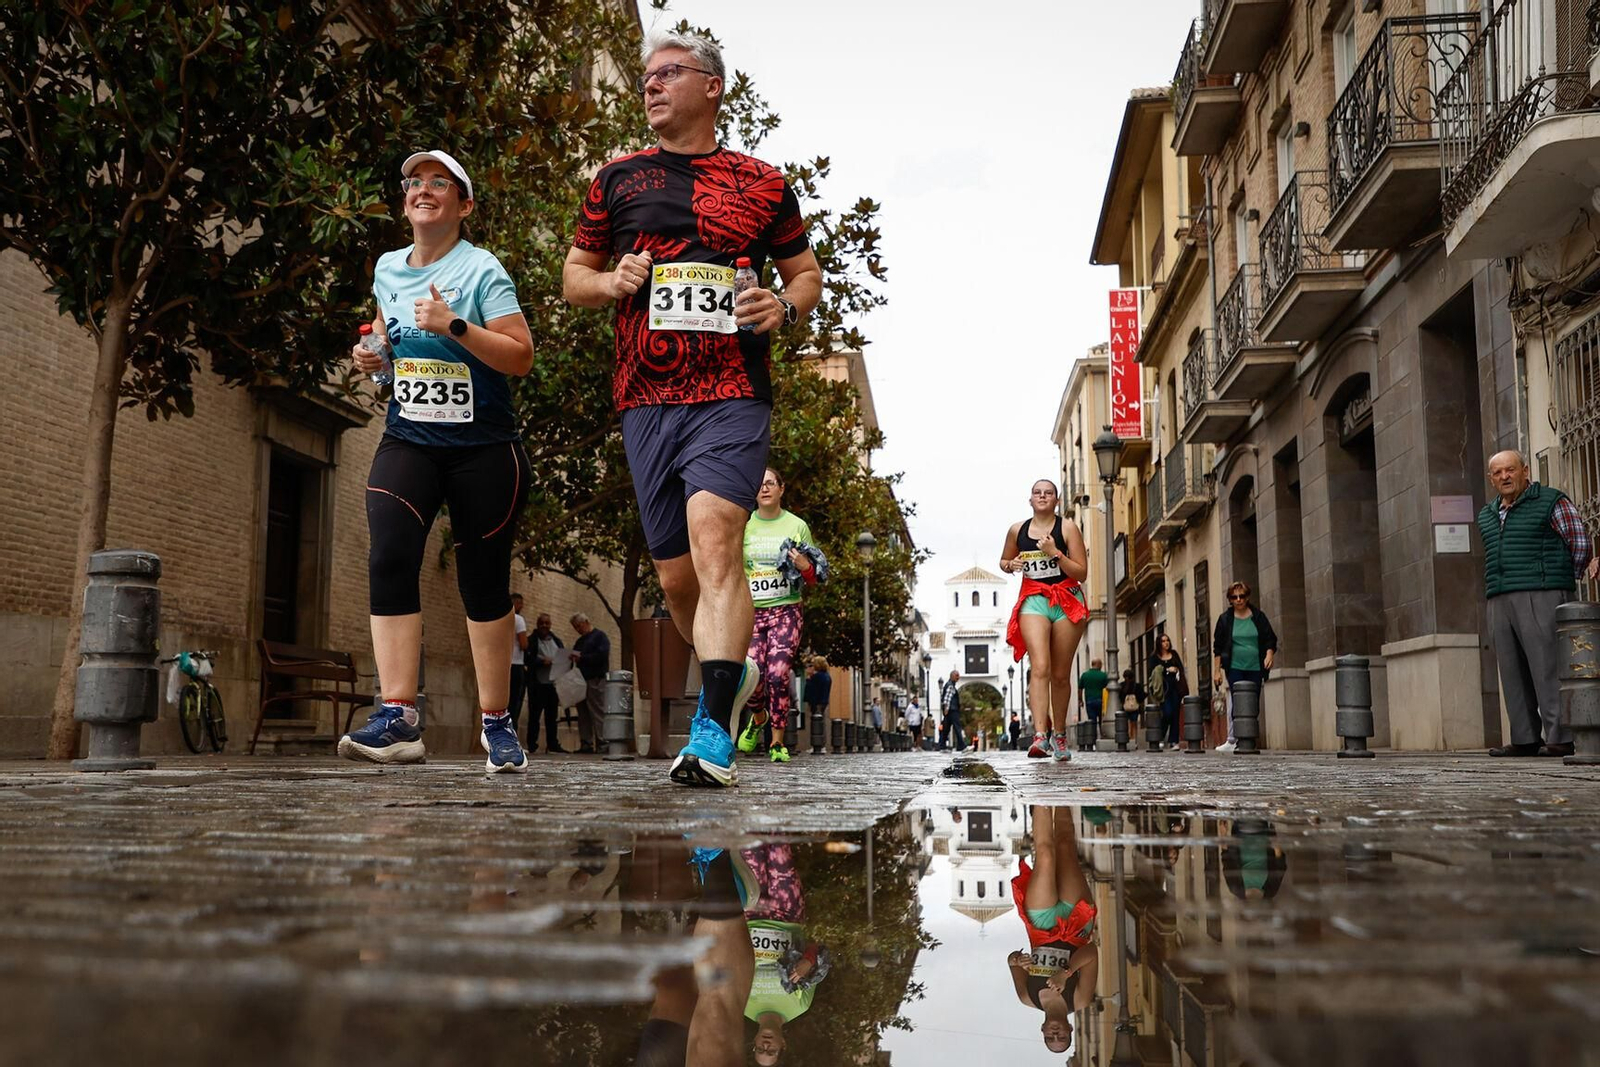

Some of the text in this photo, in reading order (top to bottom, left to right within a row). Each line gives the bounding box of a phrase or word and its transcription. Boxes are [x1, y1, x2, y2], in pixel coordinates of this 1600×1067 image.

[665, 267, 723, 282] 38 FONDO
[654, 286, 736, 317] 3134
[1127, 318, 1137, 354] BAR
[403, 362, 455, 375] 38 FONDO
[397, 380, 471, 406] 3235
[1111, 351, 1127, 419] UNIÓN
[1023, 560, 1058, 572] 3136
[751, 578, 789, 592] 3044
